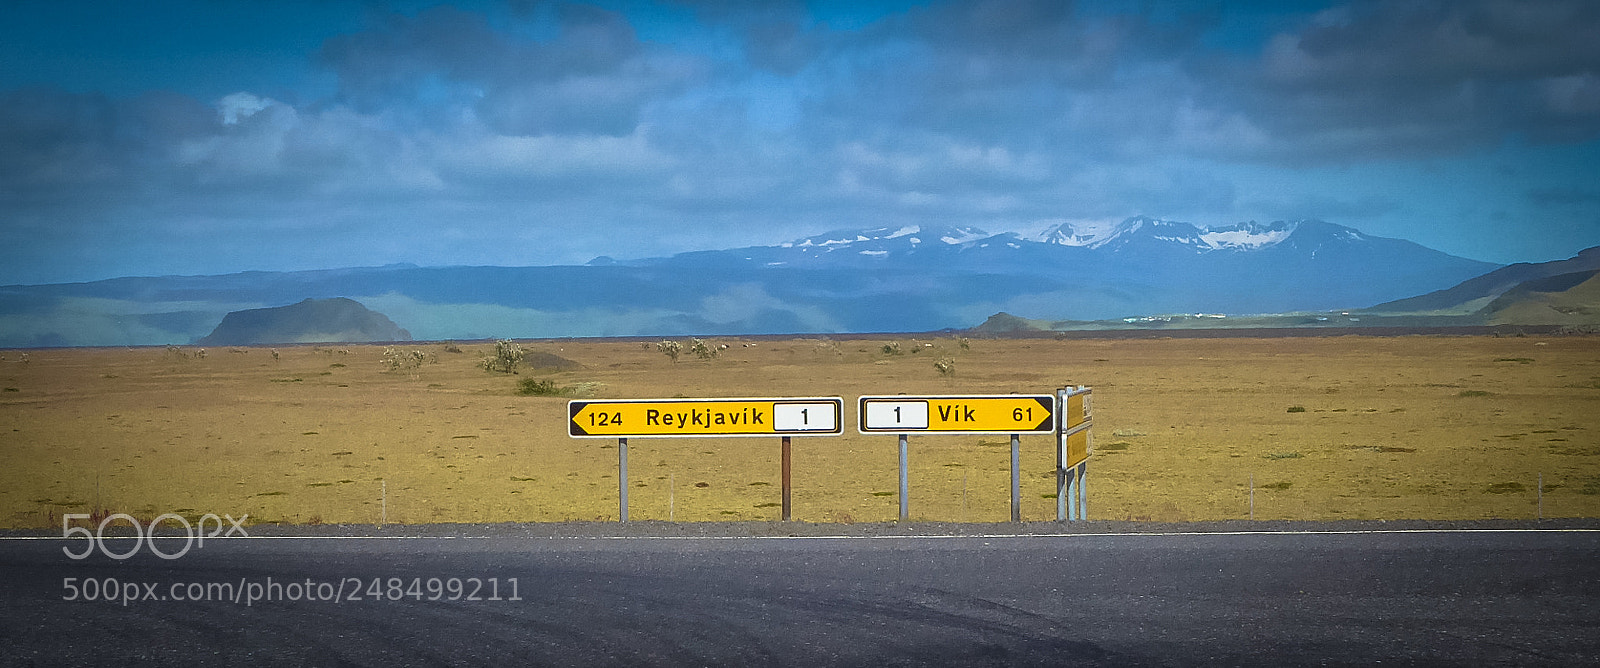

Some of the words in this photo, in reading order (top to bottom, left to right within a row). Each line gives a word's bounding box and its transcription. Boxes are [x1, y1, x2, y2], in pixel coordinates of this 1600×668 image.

[588, 411, 623, 427] 124
[646, 407, 765, 429] Reykjavík
[800, 408, 809, 425] 1
[893, 406, 902, 424] 1
[937, 404, 976, 422] Vík
[1012, 407, 1033, 422] 61
